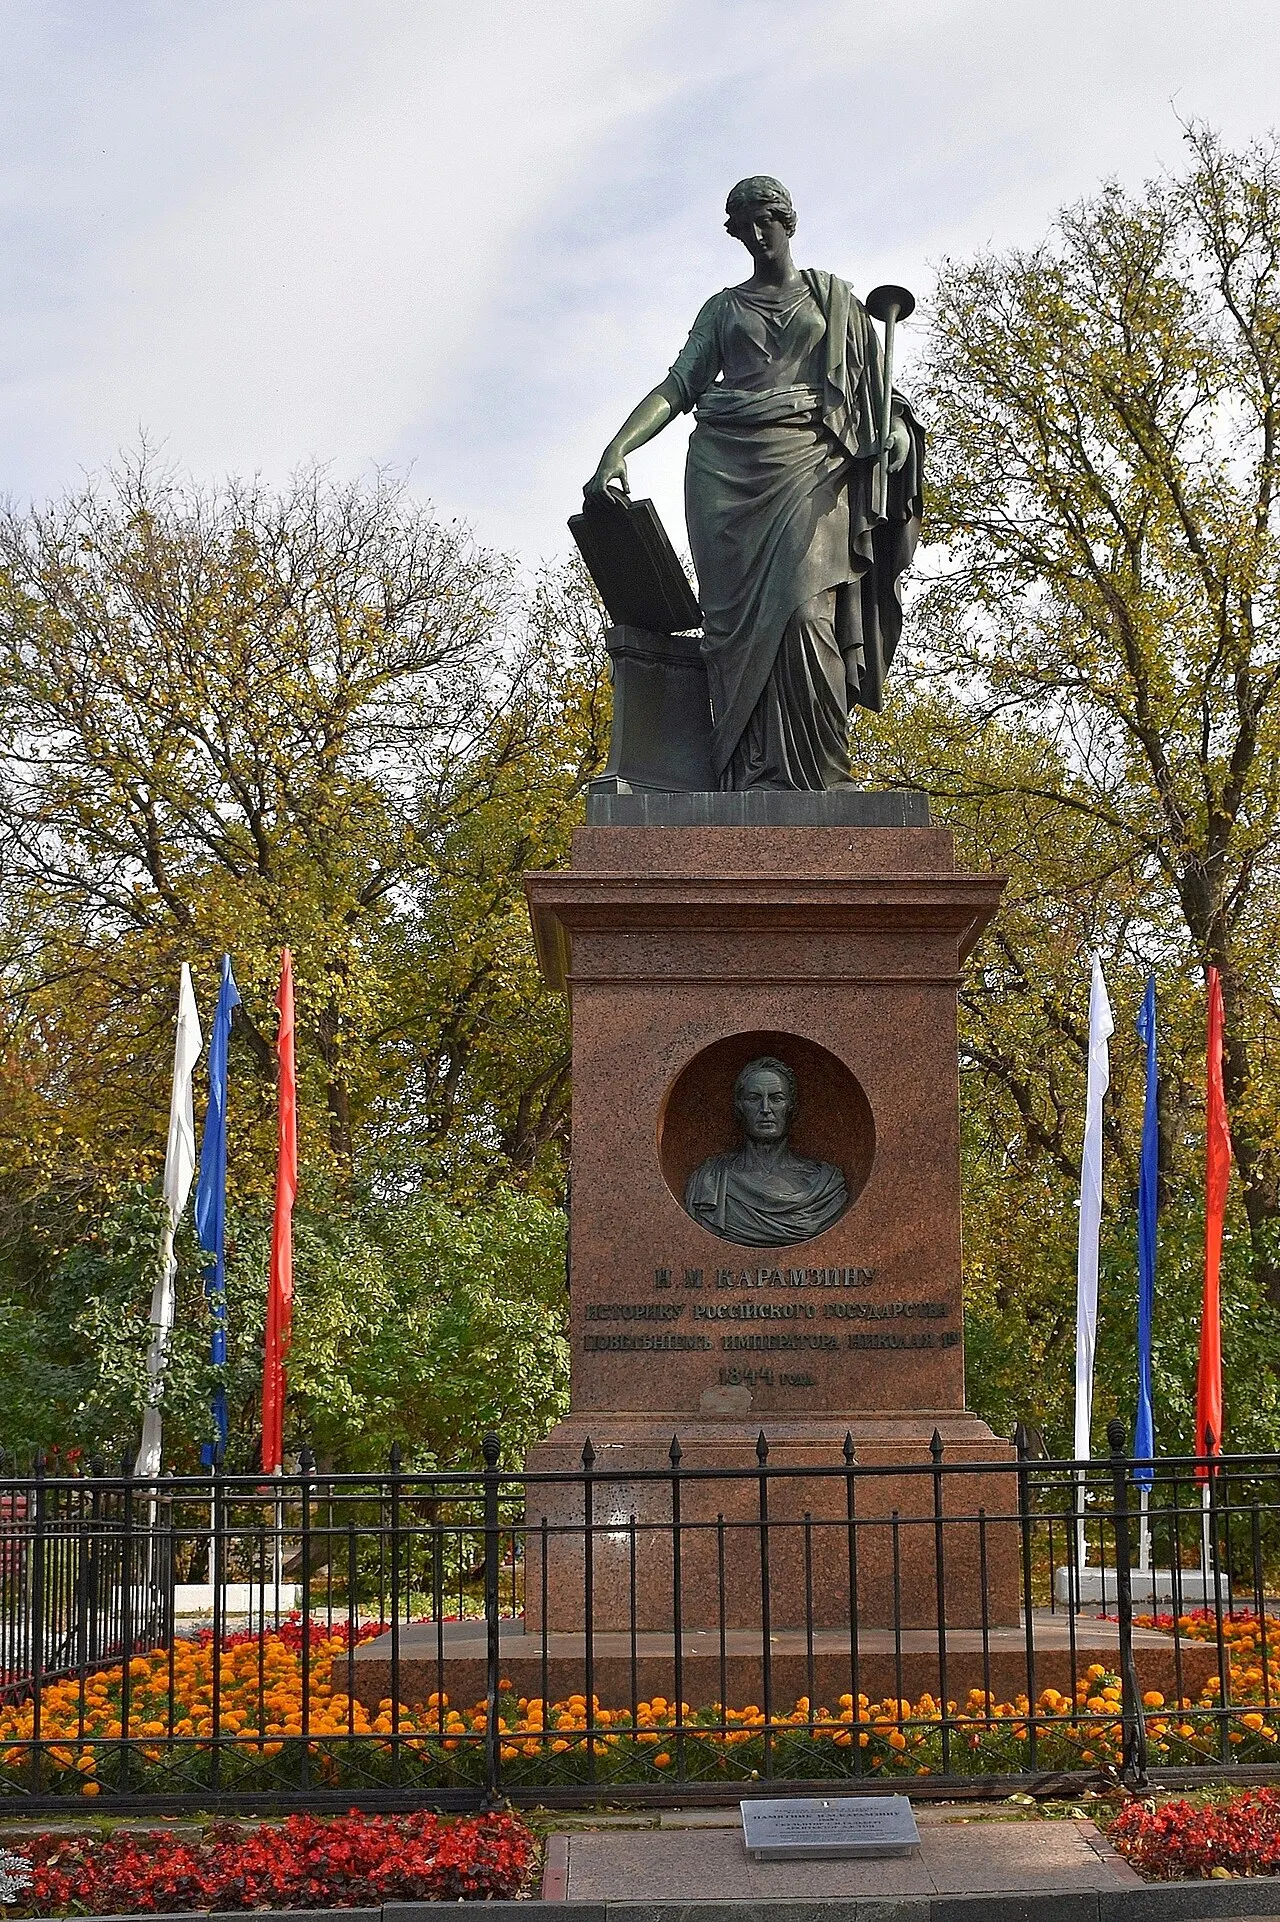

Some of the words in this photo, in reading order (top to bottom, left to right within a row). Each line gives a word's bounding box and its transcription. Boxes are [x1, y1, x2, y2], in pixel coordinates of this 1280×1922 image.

[716, 1267, 879, 1288] КАРАМЗИНУ
[585, 1303, 687, 1320] ИСТОРИКУ
[823, 1302, 949, 1321] ГОСУДАРСТВА
[721, 1334, 840, 1351] ИМПЕРАТОРА
[848, 1333, 937, 1350] НИКОЛАЯ
[719, 1367, 775, 1386] 1844
